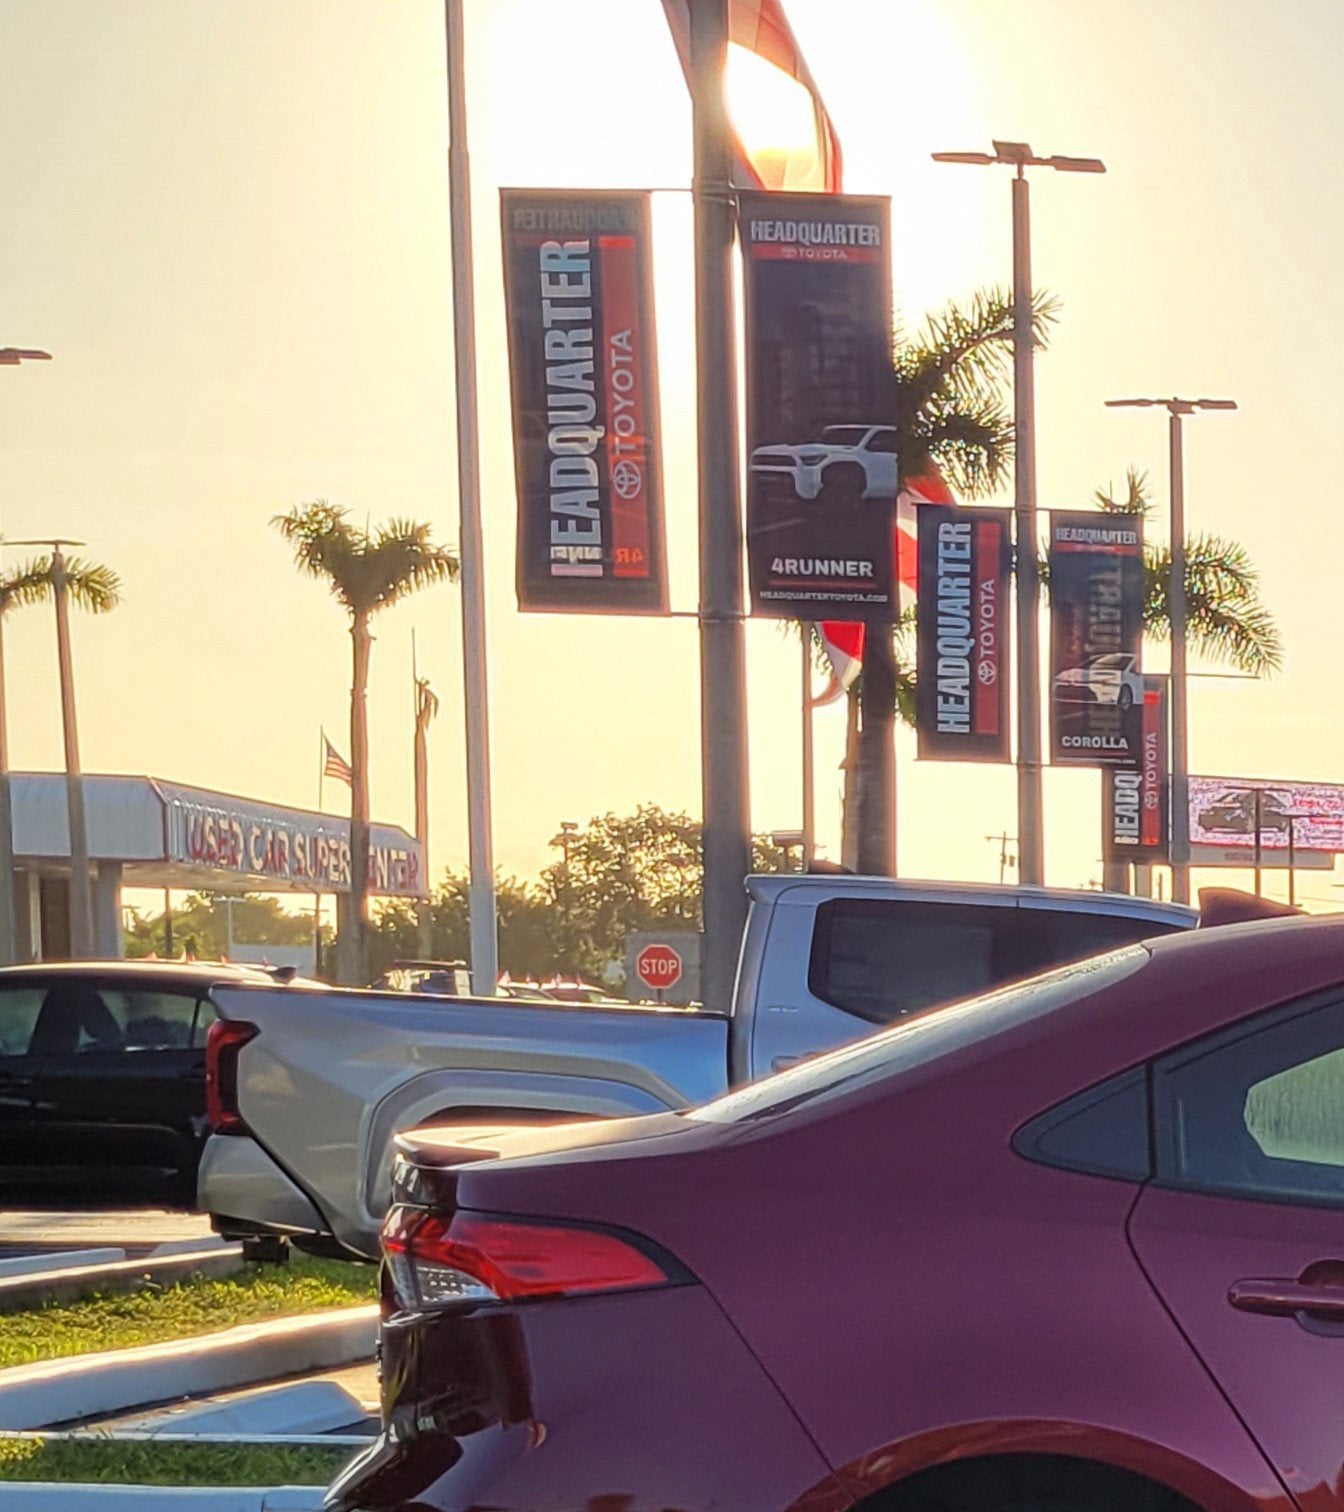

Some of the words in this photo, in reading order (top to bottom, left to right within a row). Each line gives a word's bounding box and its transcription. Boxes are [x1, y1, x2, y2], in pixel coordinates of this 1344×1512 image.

[751, 219, 881, 246] HEADQUARTER
[798, 248, 847, 259] TOYOTA
[539, 238, 606, 578] HEADQUARTER
[611, 329, 636, 456] TOYOTA
[771, 557, 873, 577] 4RUNNER
[937, 522, 975, 733] HEADQUARTER
[980, 579, 995, 657] TOYOTA
[1061, 735, 1129, 749] COROLLA
[1145, 732, 1158, 788] TOYOTA
[189, 813, 244, 867] USED
[251, 823, 290, 877] CAR
[294, 831, 351, 886] SUPER
[641, 958, 678, 975] STOP
